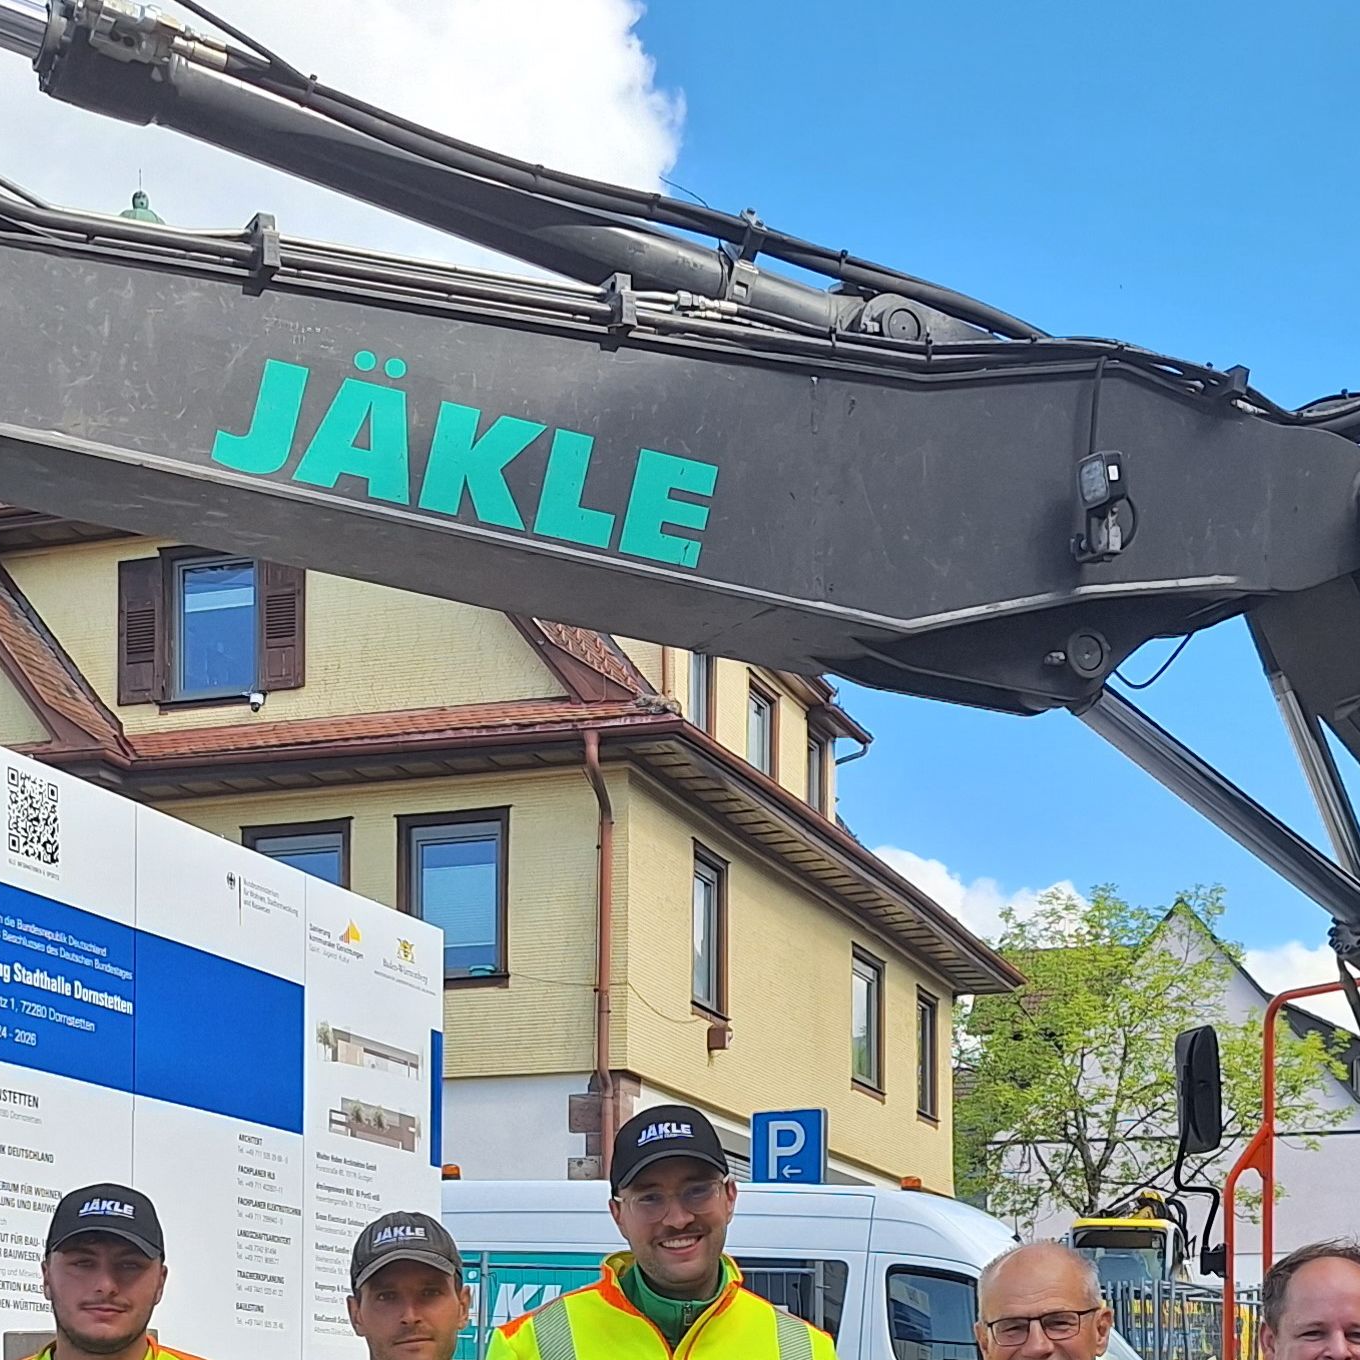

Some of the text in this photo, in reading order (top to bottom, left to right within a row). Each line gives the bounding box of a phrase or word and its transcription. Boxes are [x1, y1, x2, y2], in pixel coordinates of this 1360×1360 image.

[211, 350, 718, 568] JÄKLE
[4, 916, 15, 928] die
[17, 918, 67, 944] Bundesrepublik
[68, 934, 107, 957] Deutschland
[2, 929, 45, 952] Beschlusses
[46, 943, 58, 956] des
[60, 947, 93, 967] Deutschen
[94, 958, 133, 980] Bundestages
[13, 961, 72, 996] Stadthalle
[74, 980, 133, 1015] Dornstetten
[22, 1001, 47, 1019] 72280
[49, 1008, 95, 1032] Dornstetten
[15, 1029, 37, 1046] 2026
[637, 1122, 692, 1143] JÄKLE
[7, 1145, 54, 1163] DEUTSCHLAND
[768, 1120, 806, 1180] P
[21, 1182, 33, 1195] FÜR
[17, 1199, 31, 1210] UND
[33, 1201, 56, 1214] BAUWE
[79, 1198, 135, 1214] JÄKLE
[11, 1232, 23, 1245] FÜR
[373, 1225, 426, 1244] JÄKLE
[3, 1247, 40, 1262] BAUWESEN
[23, 1282, 44, 1294] KARLS
